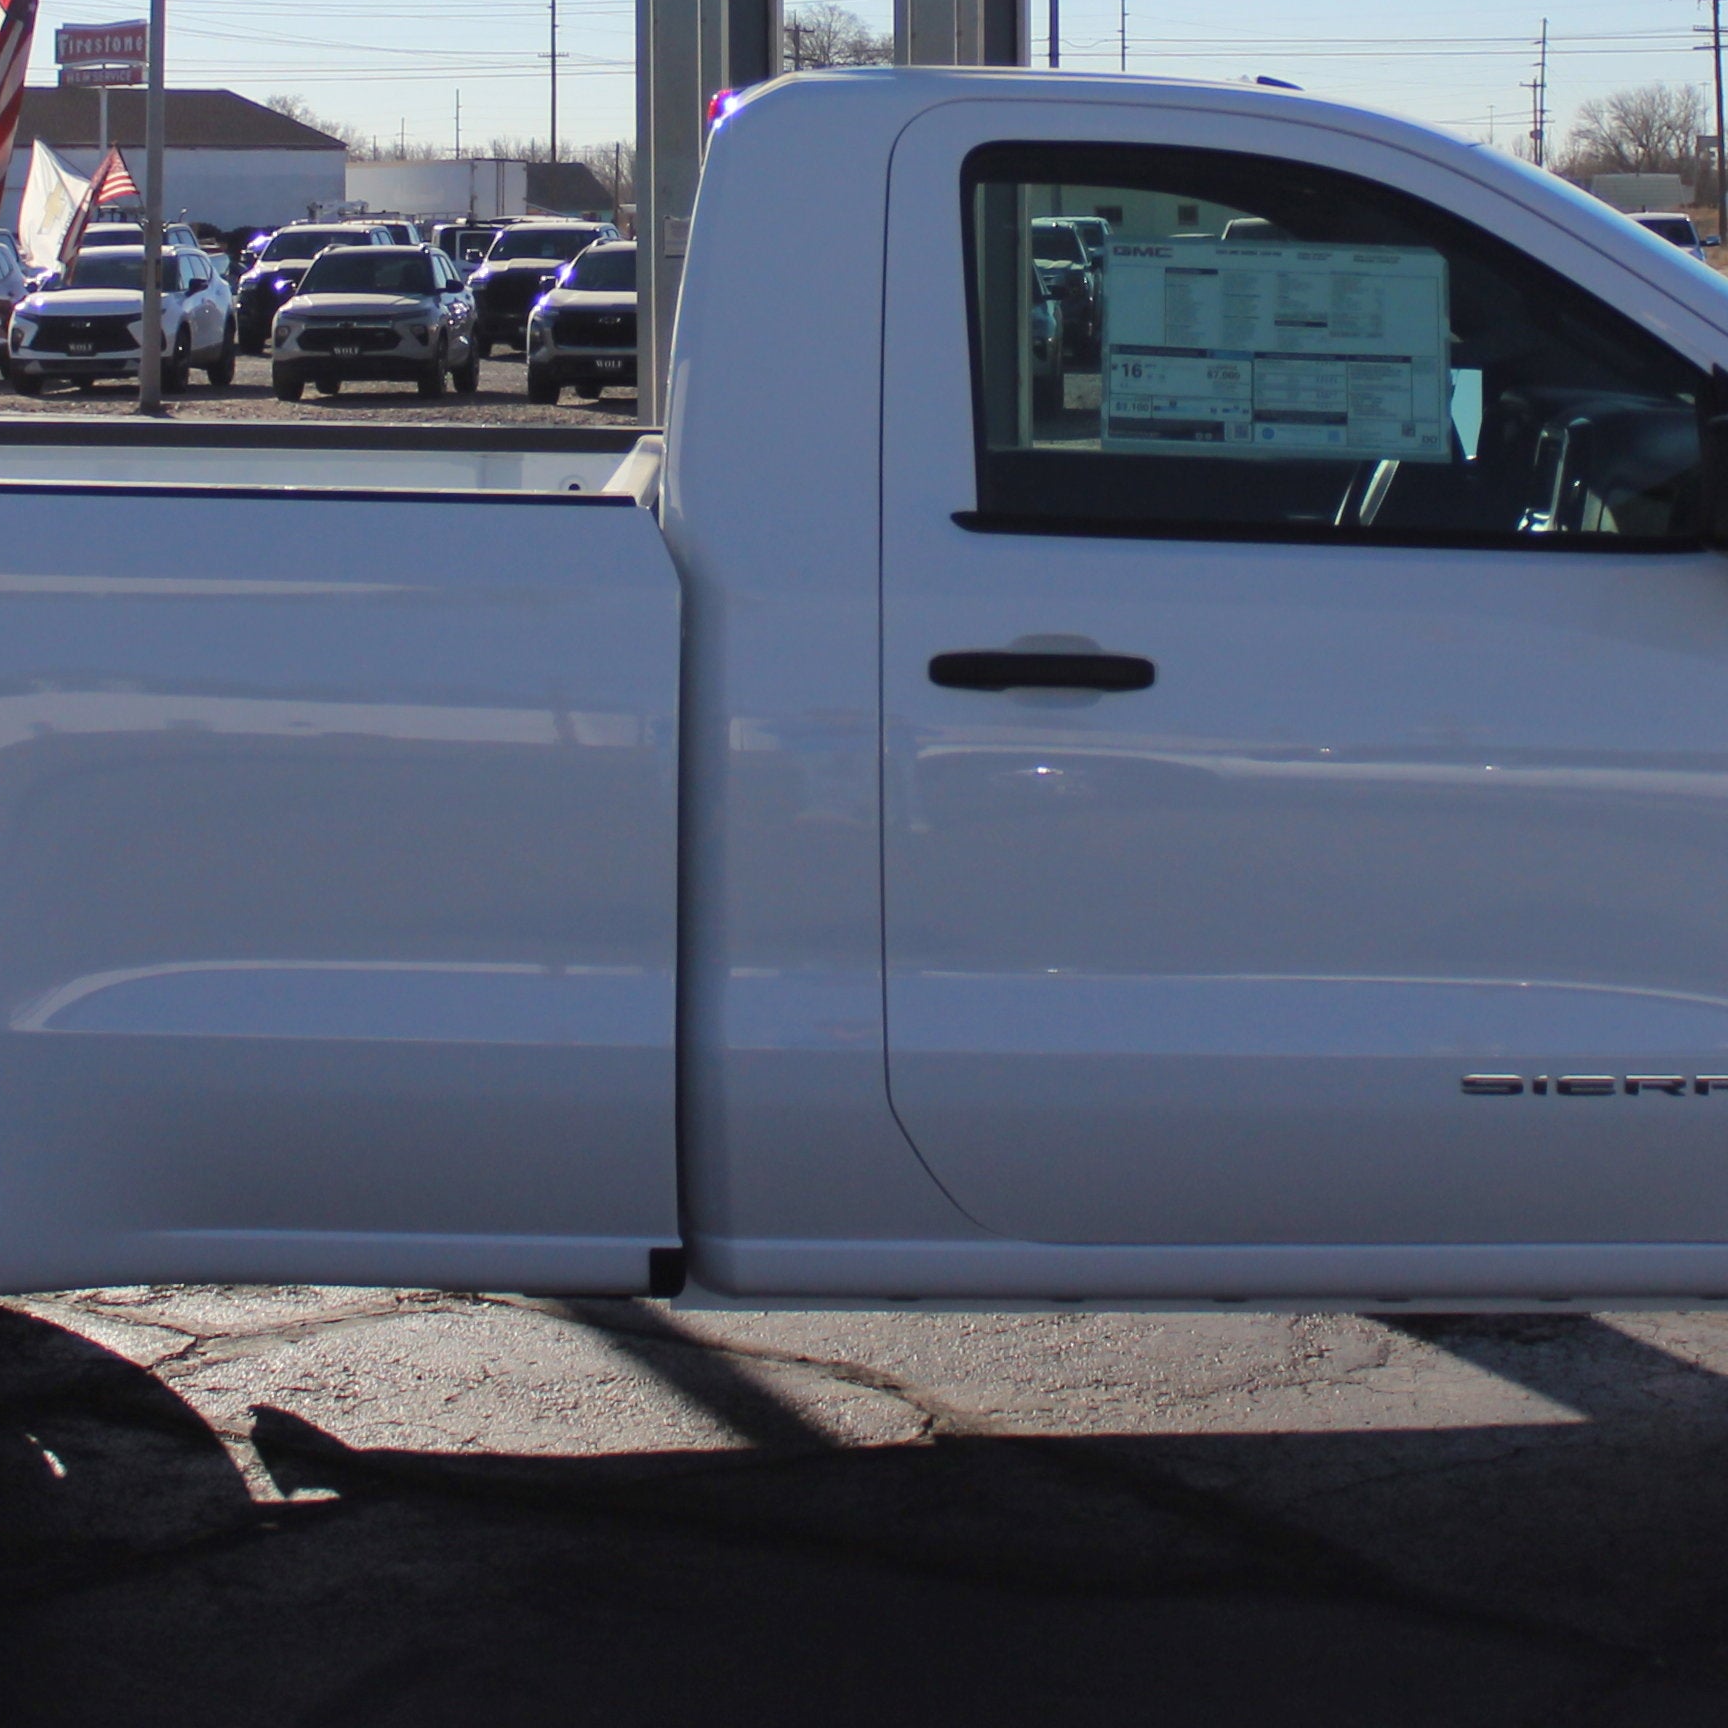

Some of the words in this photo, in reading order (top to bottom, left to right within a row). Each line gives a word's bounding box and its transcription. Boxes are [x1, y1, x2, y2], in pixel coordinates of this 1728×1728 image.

[58, 33, 143, 56] Firestone
[1113, 246, 1173, 258] GMC
[595, 359, 623, 369] WOLF
